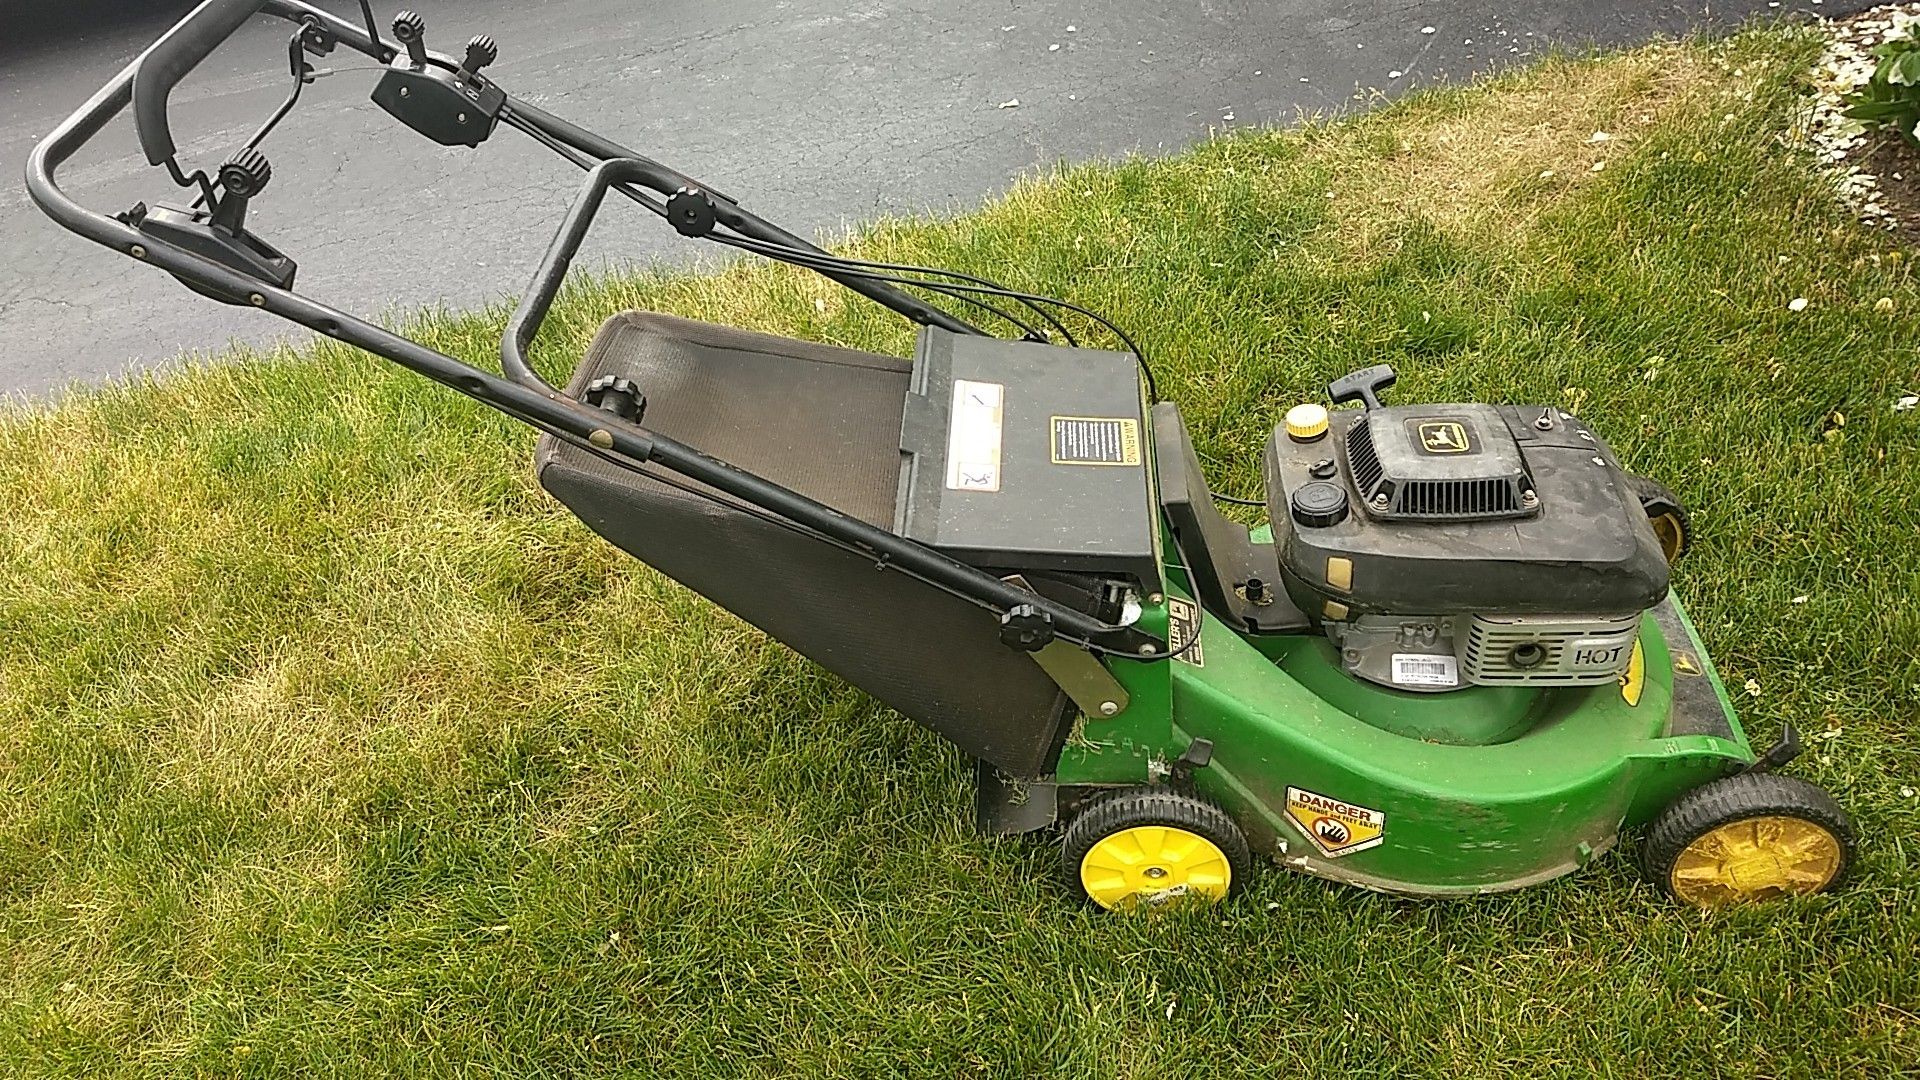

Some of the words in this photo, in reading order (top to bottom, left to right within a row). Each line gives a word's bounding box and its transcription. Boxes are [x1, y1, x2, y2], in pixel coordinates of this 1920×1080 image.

[1344, 369, 1375, 383] START
[1124, 426, 1137, 463] WARNING
[1575, 647, 1624, 665] HOT
[1292, 801, 1307, 809] KEEP
[1308, 806, 1328, 816] HANDS
[1342, 817, 1358, 825] FEET
[1359, 821, 1378, 830] AWAY
[1299, 793, 1372, 821] DANGER
